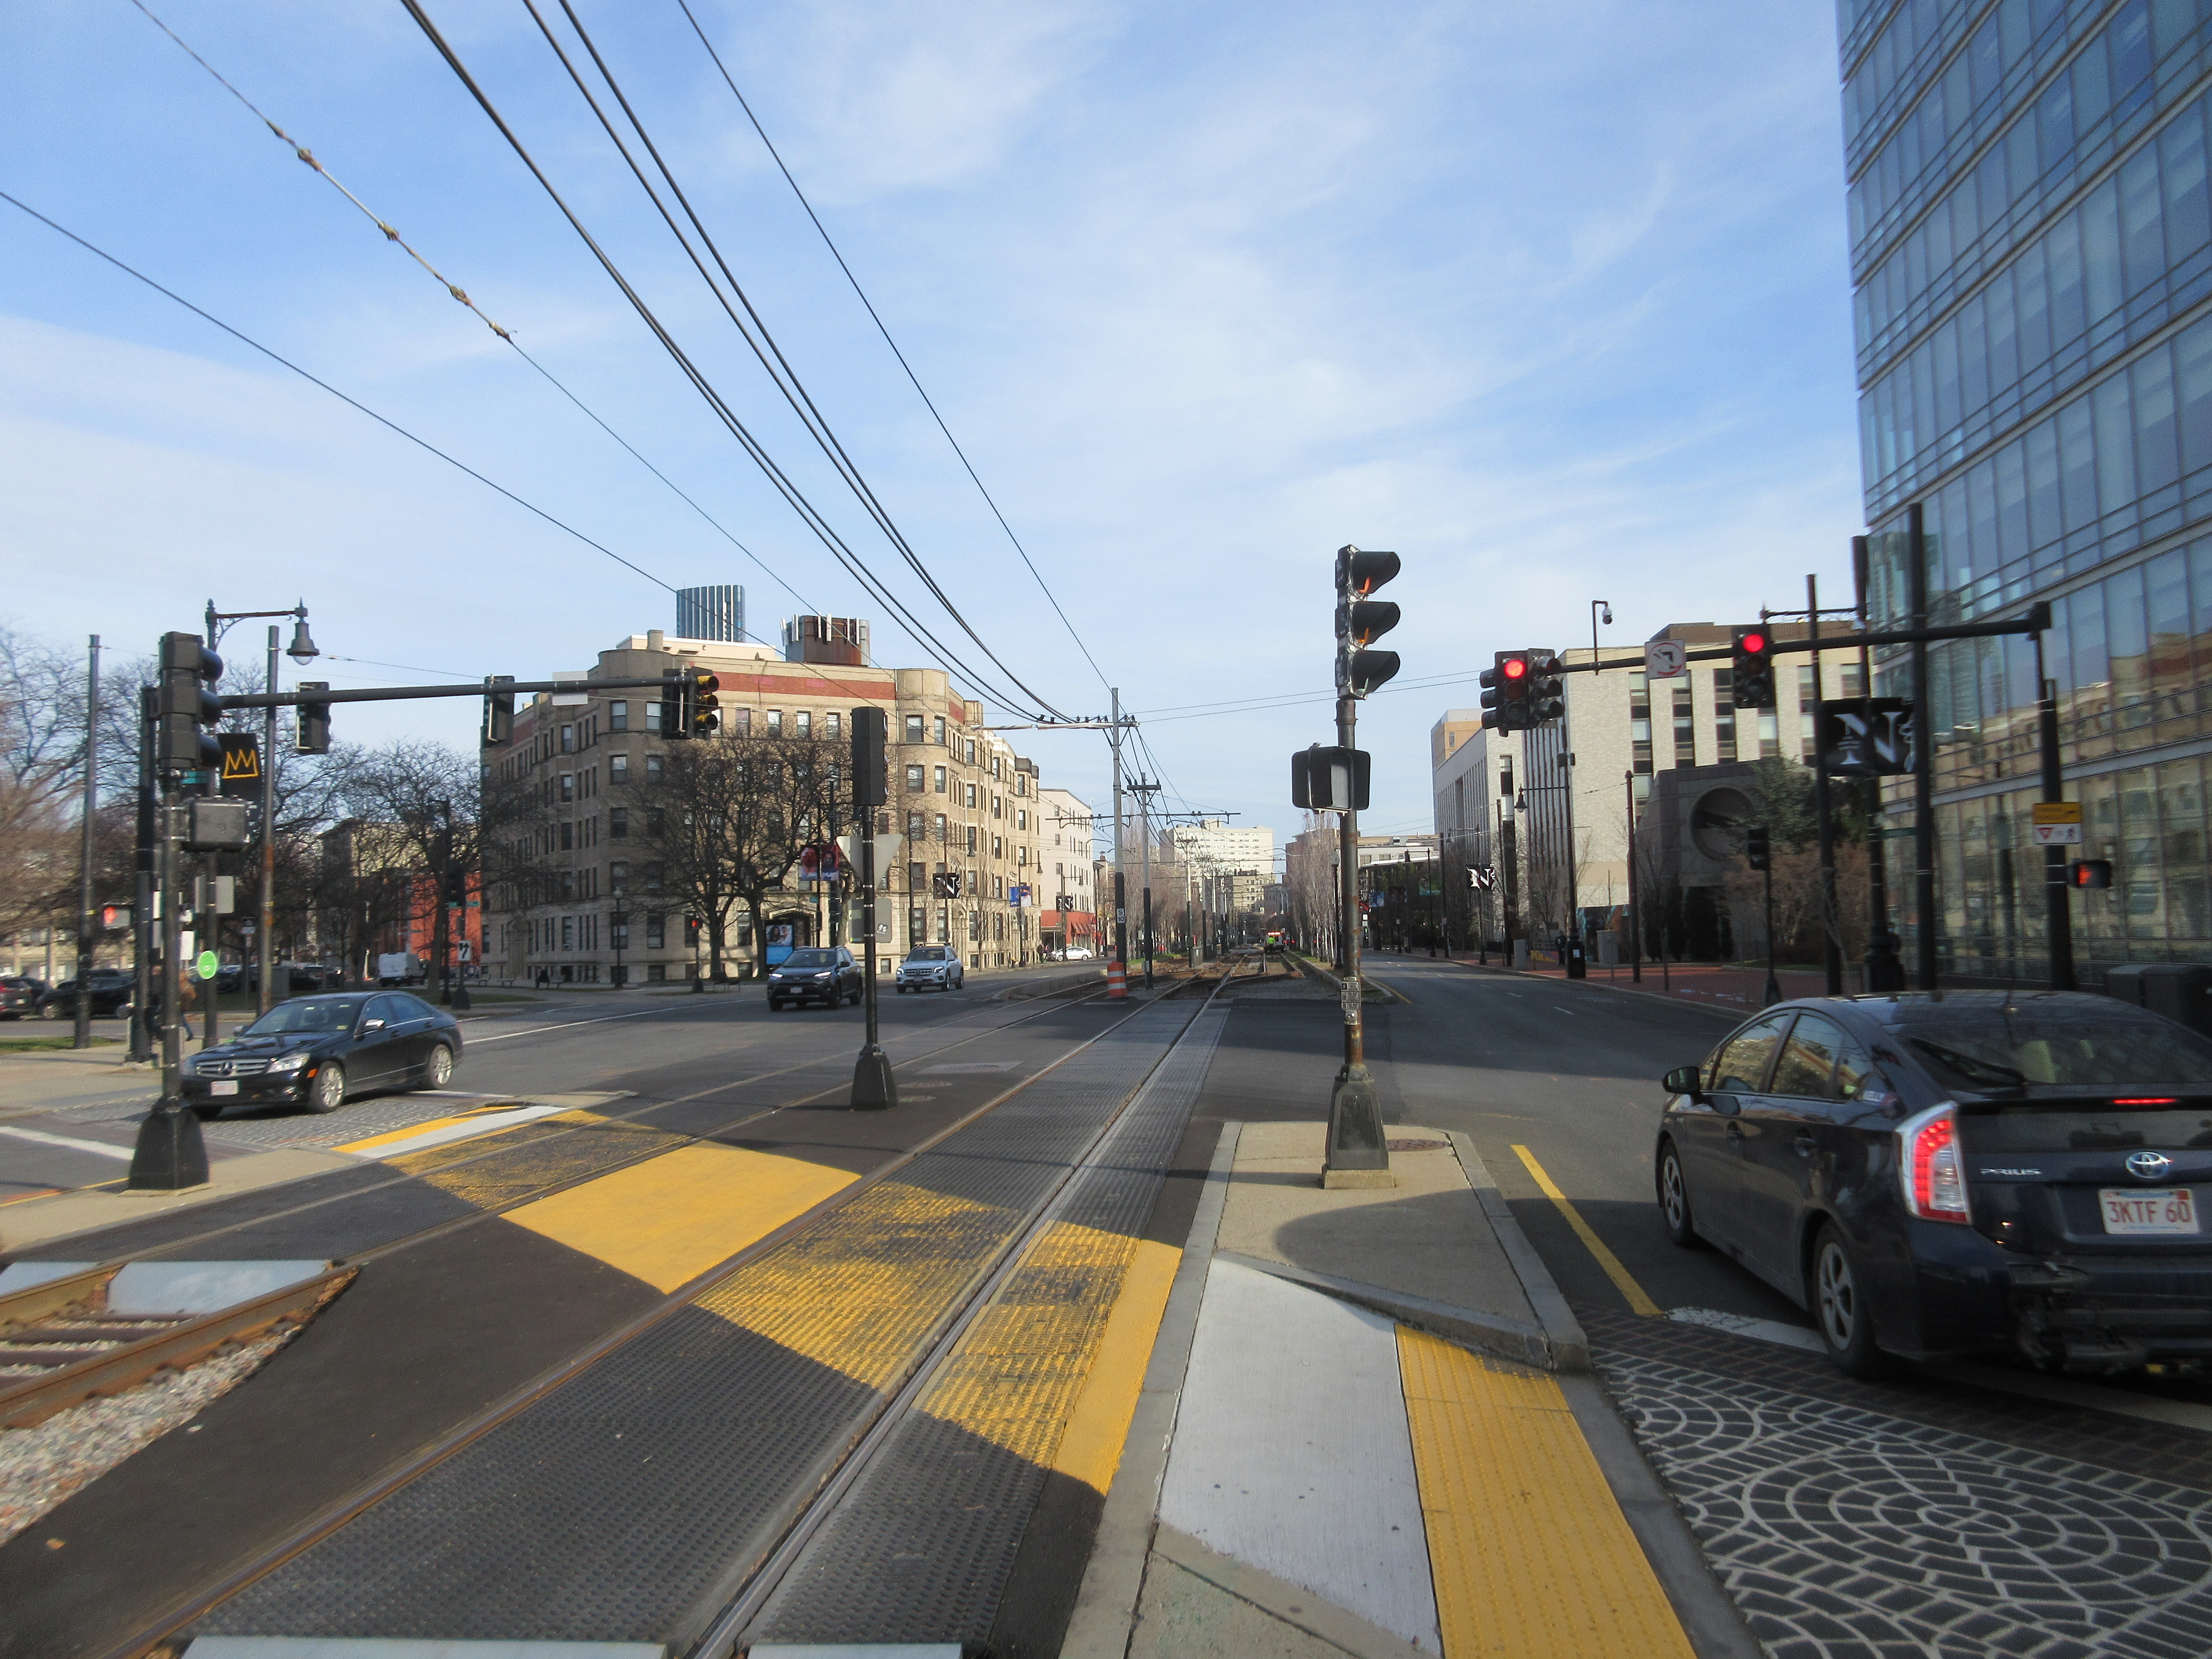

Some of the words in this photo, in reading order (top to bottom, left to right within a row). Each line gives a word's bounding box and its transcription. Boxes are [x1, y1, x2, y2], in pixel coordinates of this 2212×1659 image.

[1833, 711, 1904, 765] N
[2107, 1201, 2158, 1222] 3KTF
[2165, 1201, 2192, 1222] 60
